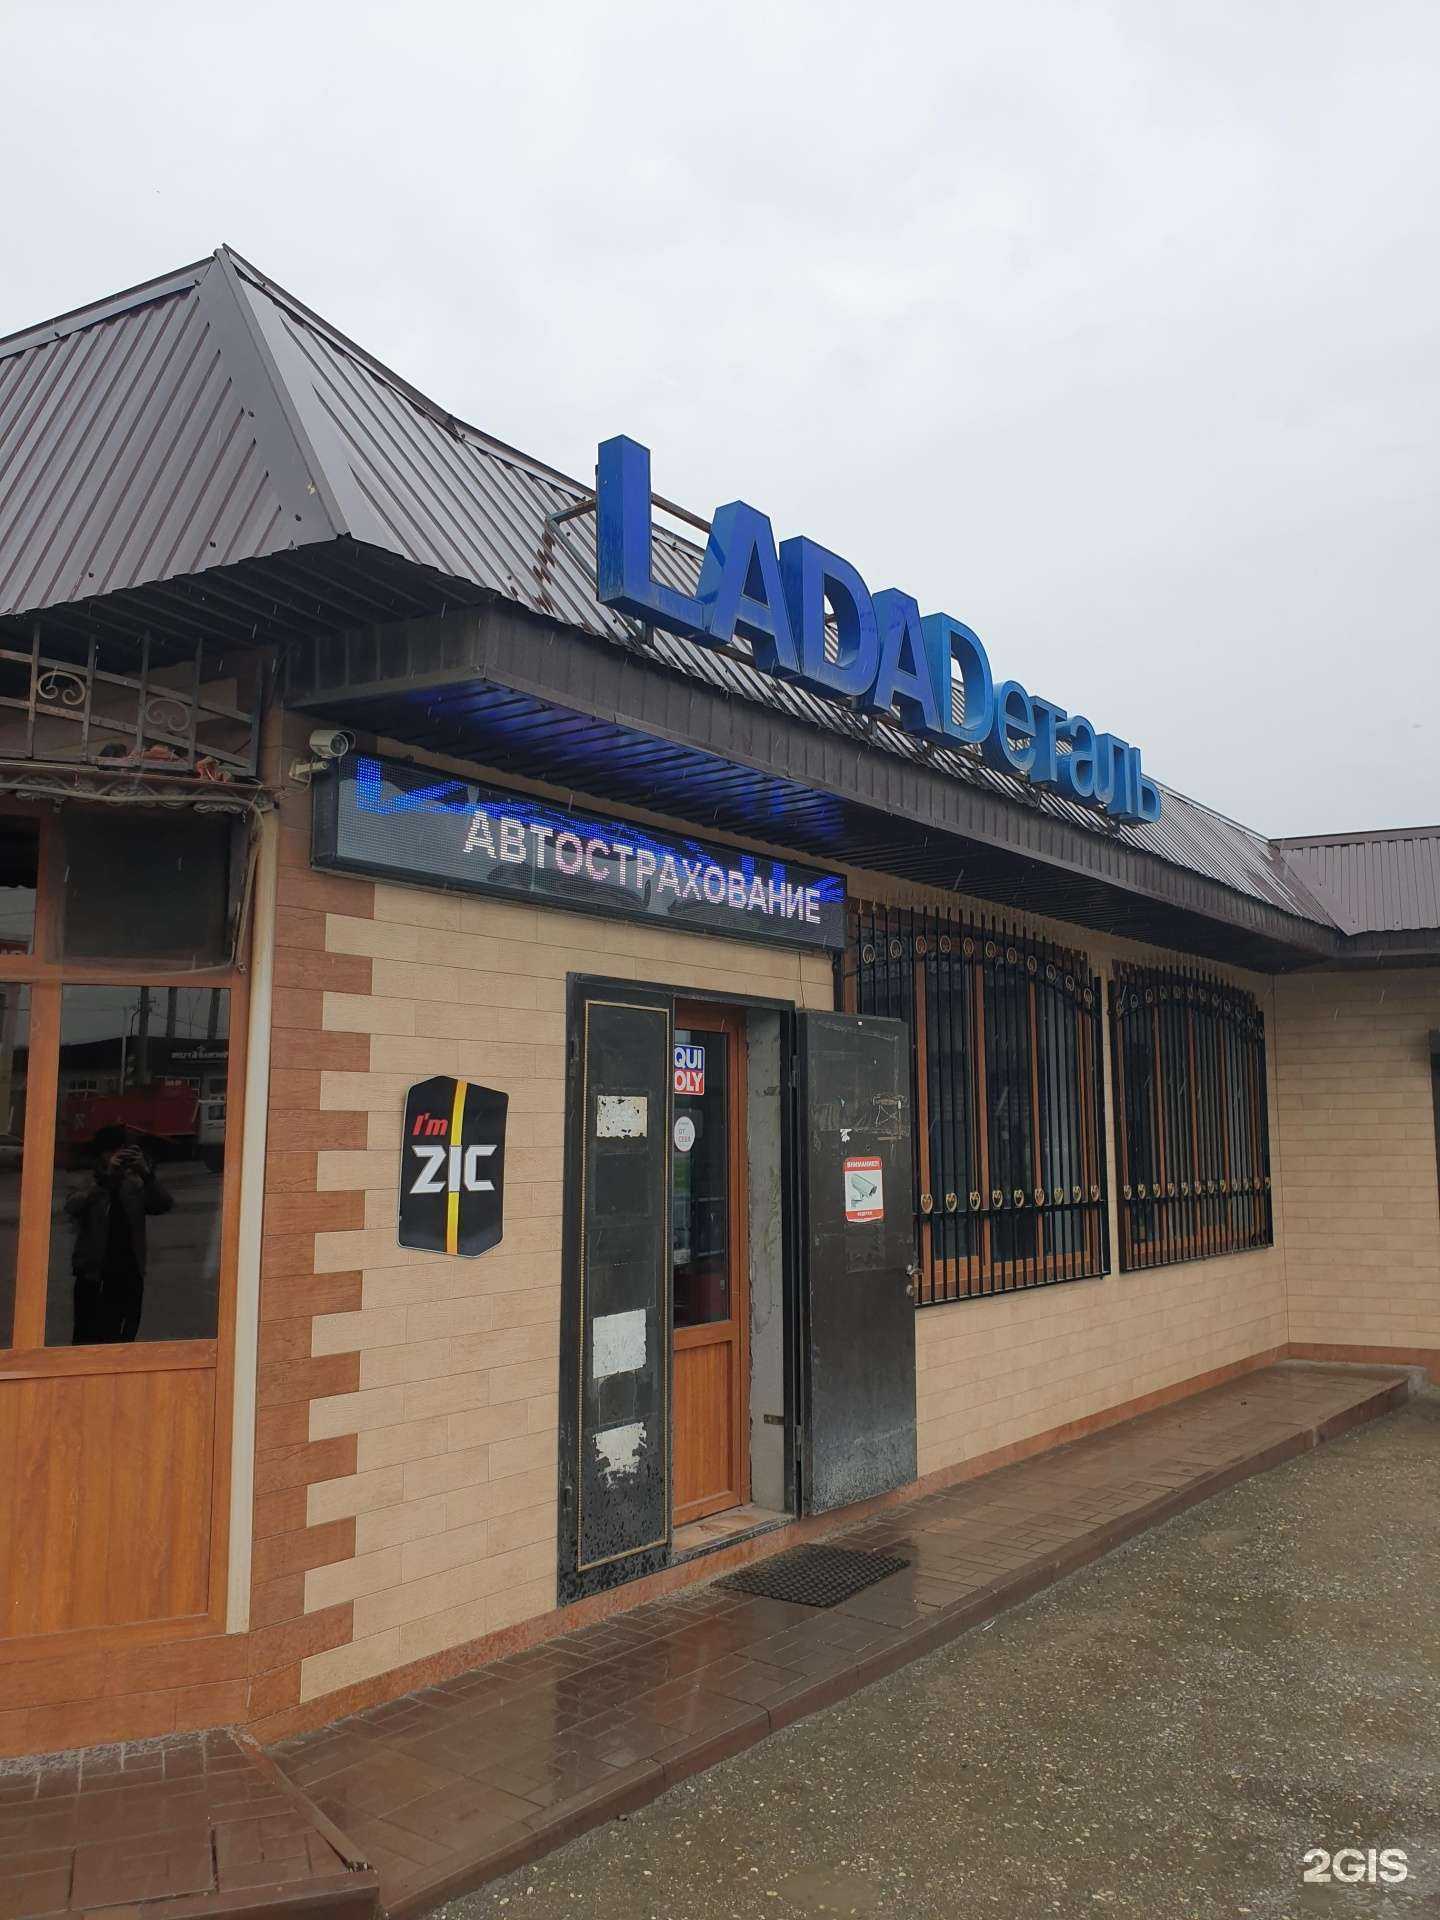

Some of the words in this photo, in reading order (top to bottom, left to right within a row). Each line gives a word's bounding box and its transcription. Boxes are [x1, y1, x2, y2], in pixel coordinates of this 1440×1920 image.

[463, 810, 822, 925] АВТОСТРАХОВАНИЕ
[412, 1113, 448, 1136] I'm
[410, 1145, 498, 1194] ZIC
